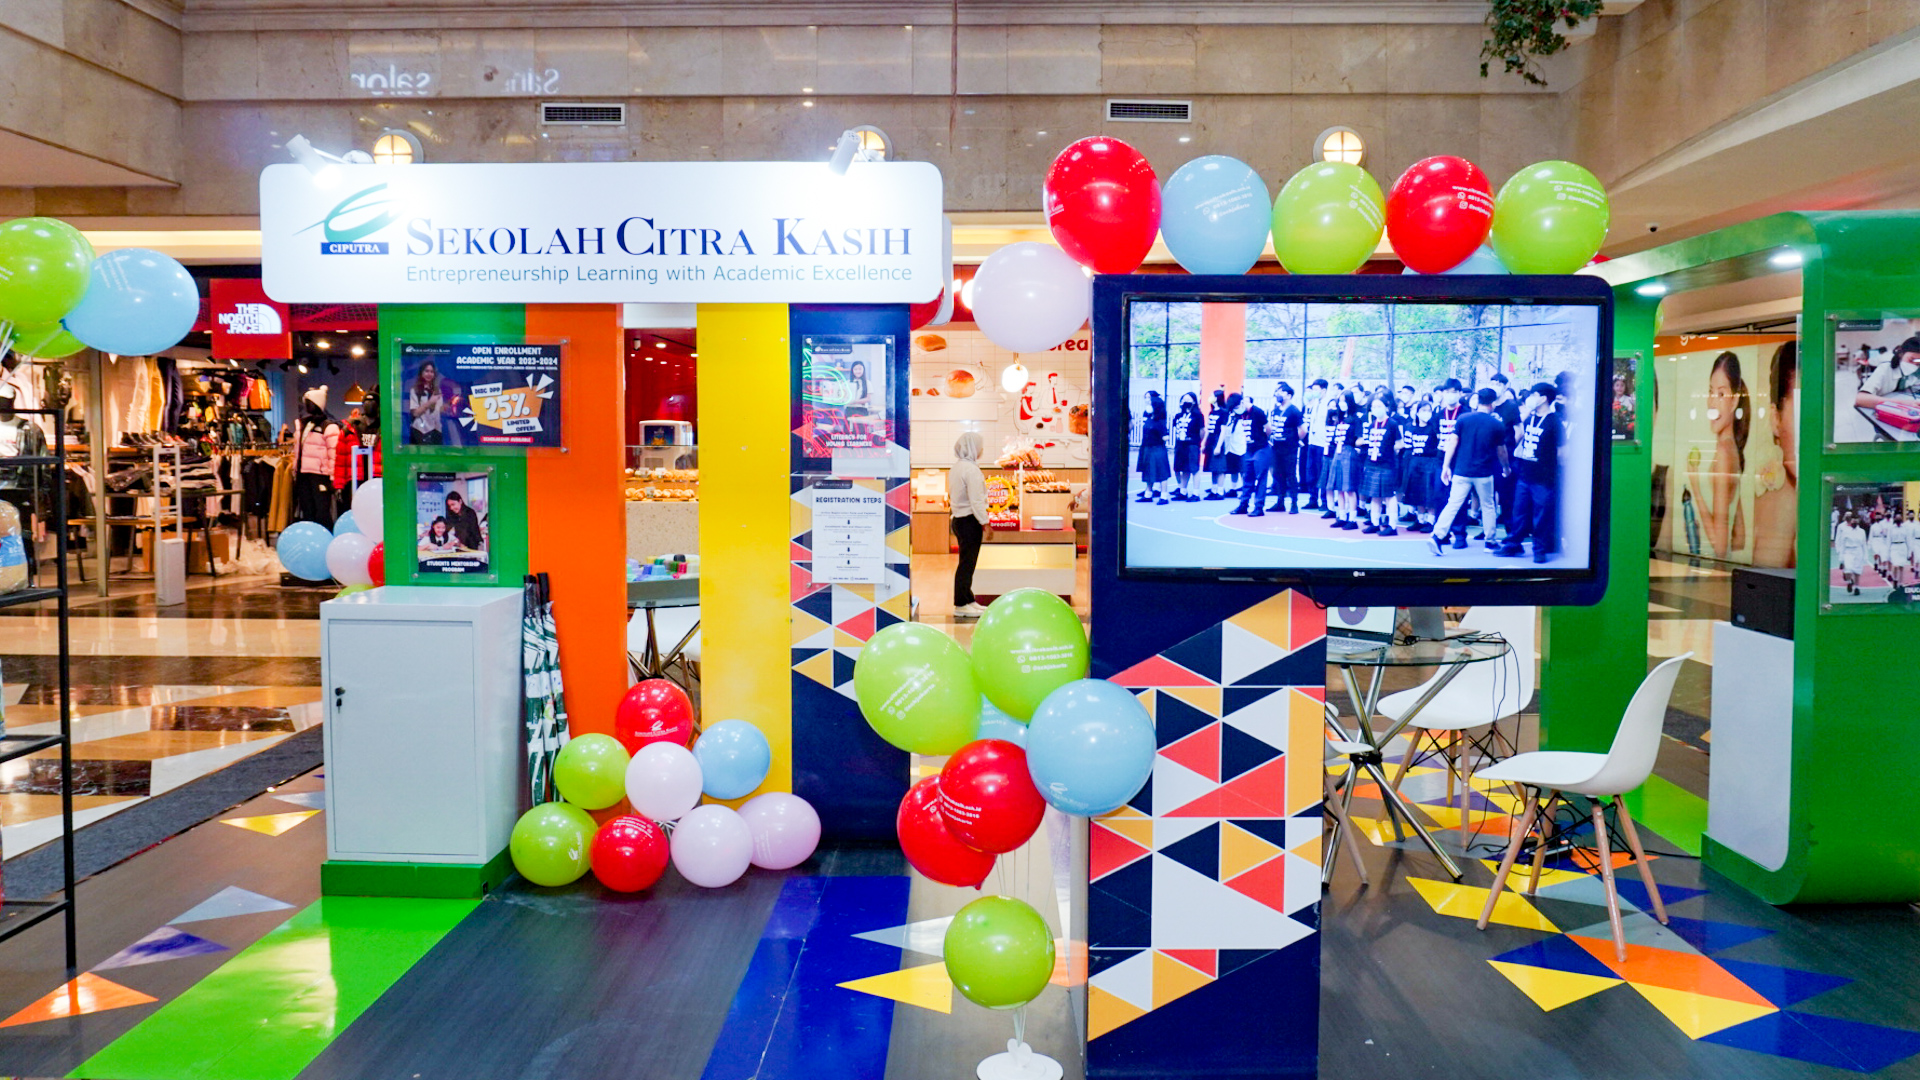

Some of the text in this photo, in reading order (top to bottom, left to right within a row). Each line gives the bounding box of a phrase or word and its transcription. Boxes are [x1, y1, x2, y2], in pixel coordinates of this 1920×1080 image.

[406, 217, 912, 256] SEKOLAH CITRA KASIH
[329, 243, 381, 253] CIPUTRA
[407, 265, 913, 285] Entrepreneurship Learning with Academic Excellence
[235, 304, 259, 314] THE
[218, 313, 259, 325] NORTH
[229, 324, 260, 335] FACE
[472, 346, 542, 355] OPEN ENROLLMENT
[456, 356, 558, 366] ACADEMIC YEAR 2023-2024
[484, 393, 531, 421] 25%
